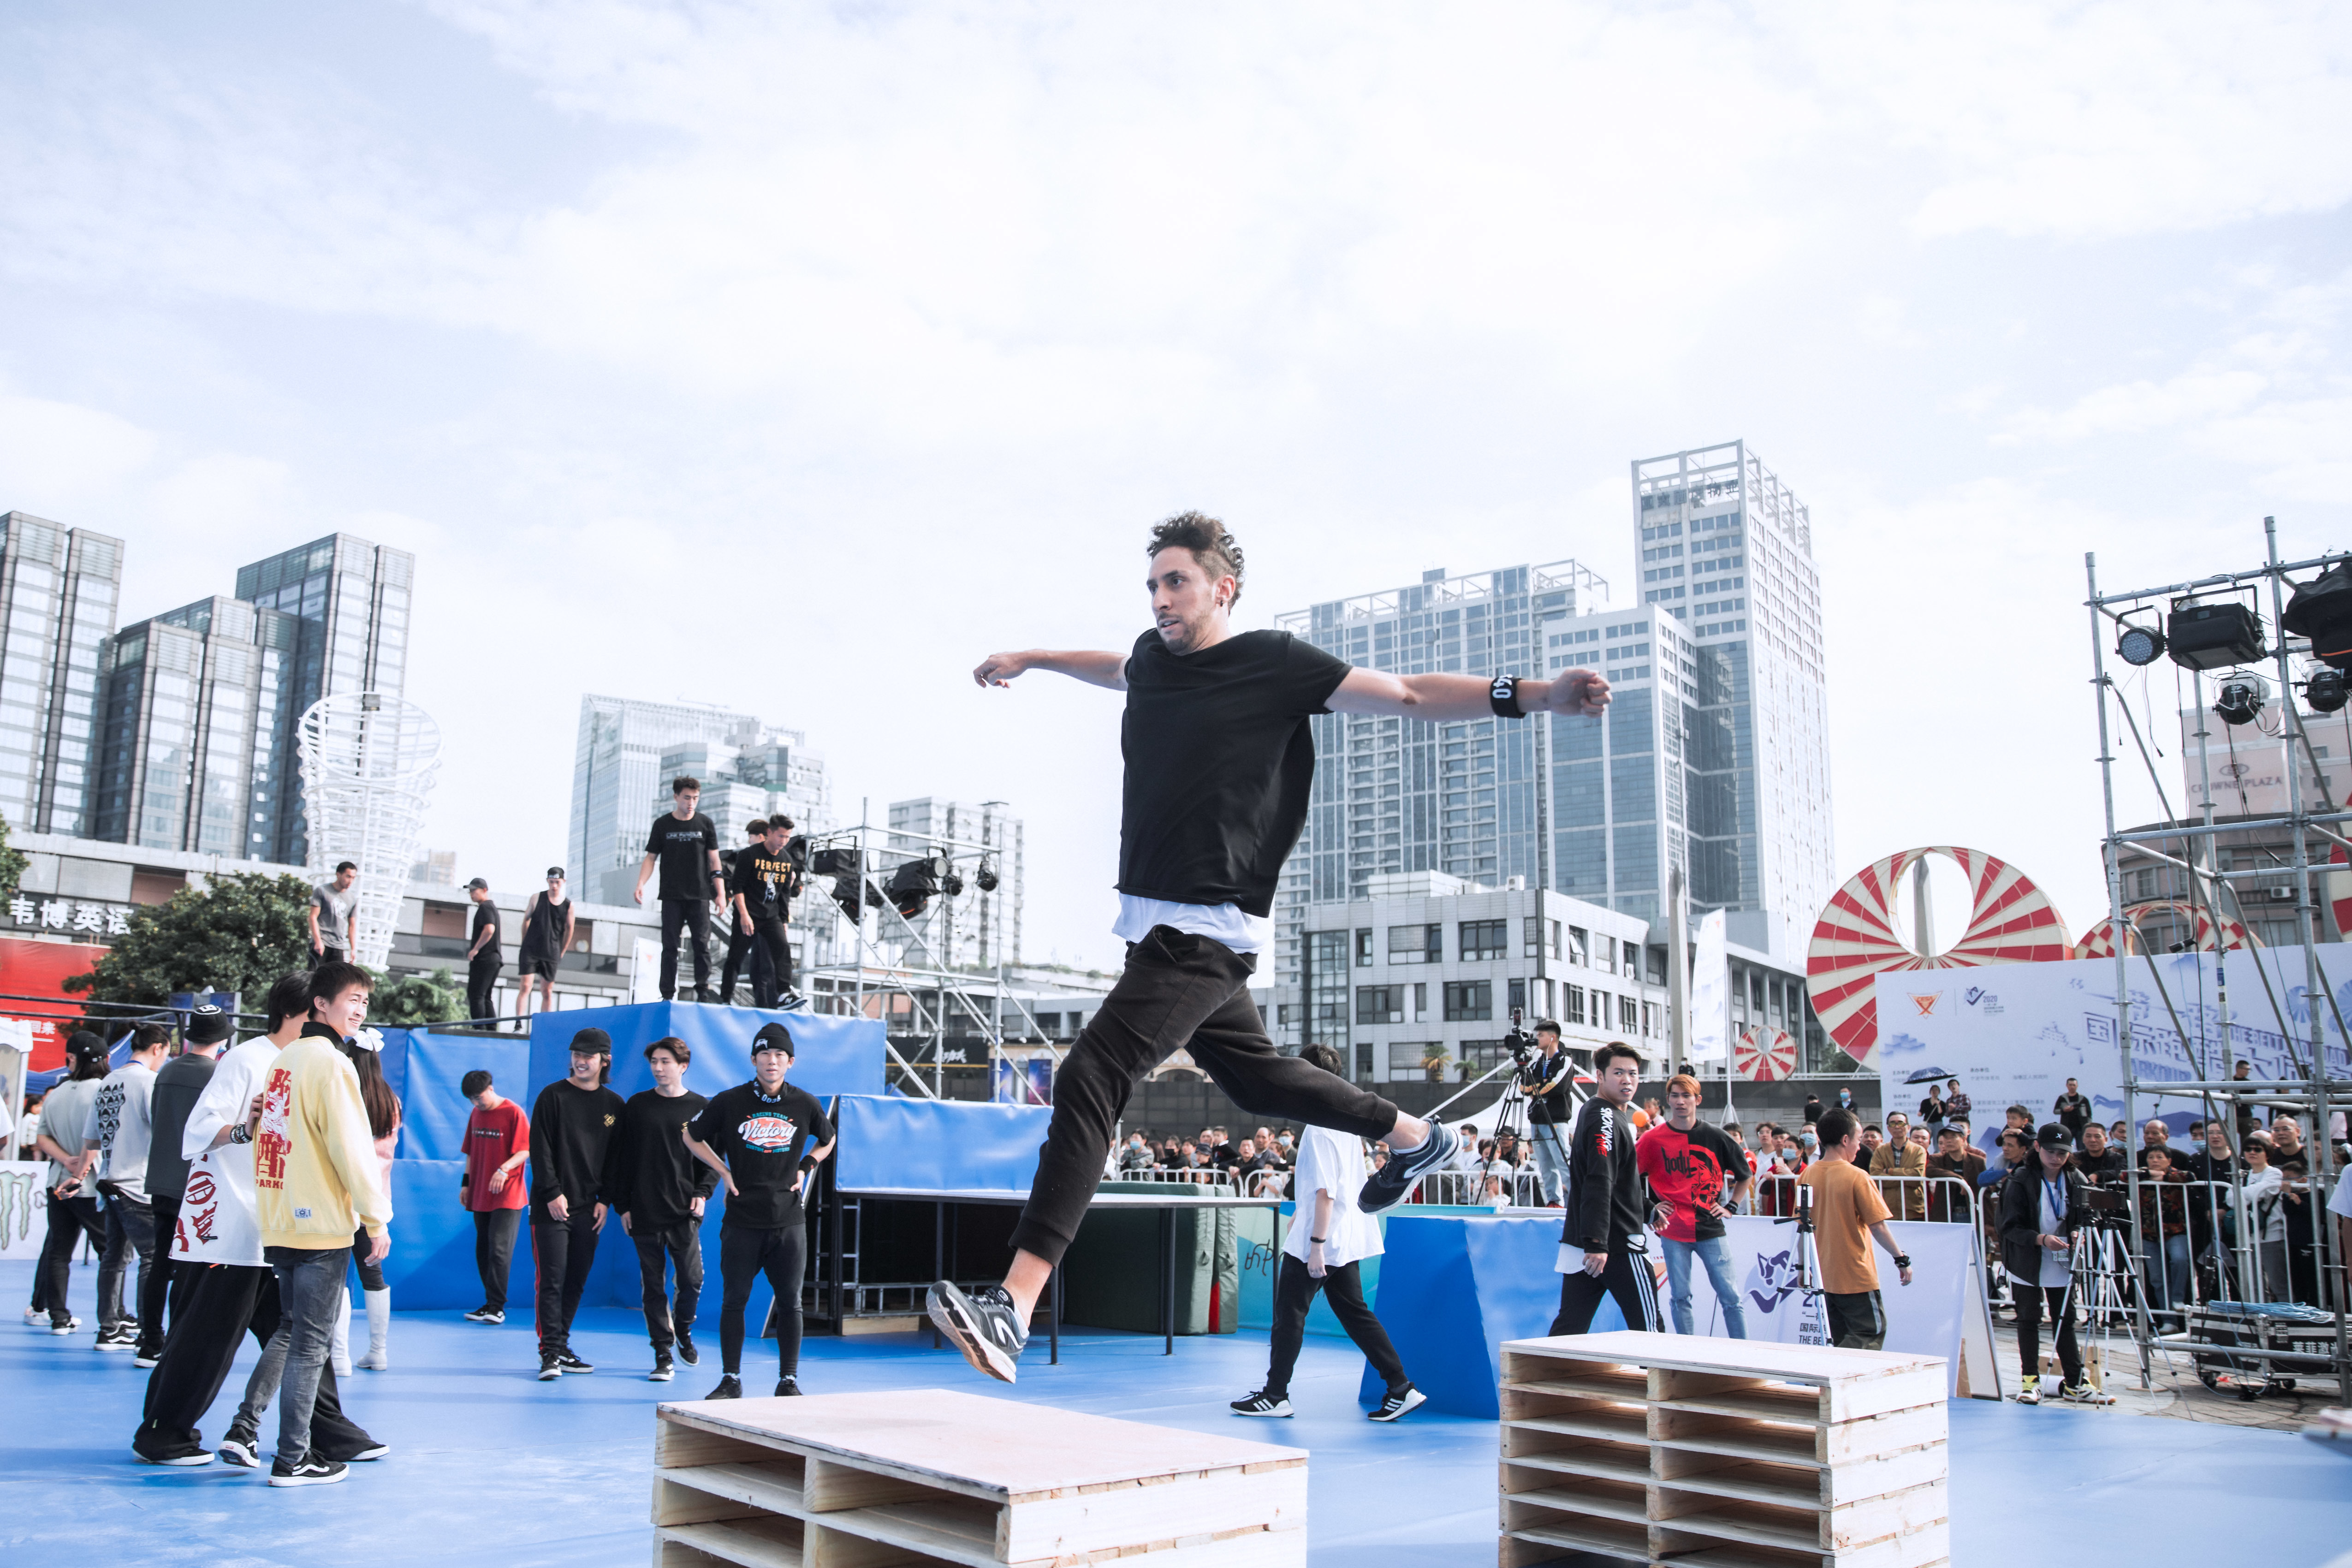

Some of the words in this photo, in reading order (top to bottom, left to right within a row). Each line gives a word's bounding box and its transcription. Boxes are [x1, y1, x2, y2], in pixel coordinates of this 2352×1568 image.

[1492, 674, 1513, 698] 40
[2245, 777, 2282, 787] PLAZA
[10, 893, 134, 935] 韦博英语
[773, 1112, 788, 1121] TEAM
[738, 1120, 798, 1143] Victory
[1661, 1146, 1696, 1179] body
[1800, 1323, 1821, 1333] 国际
[1799, 1335, 1812, 1344] THE
[1813, 1336, 1822, 1345] BE
